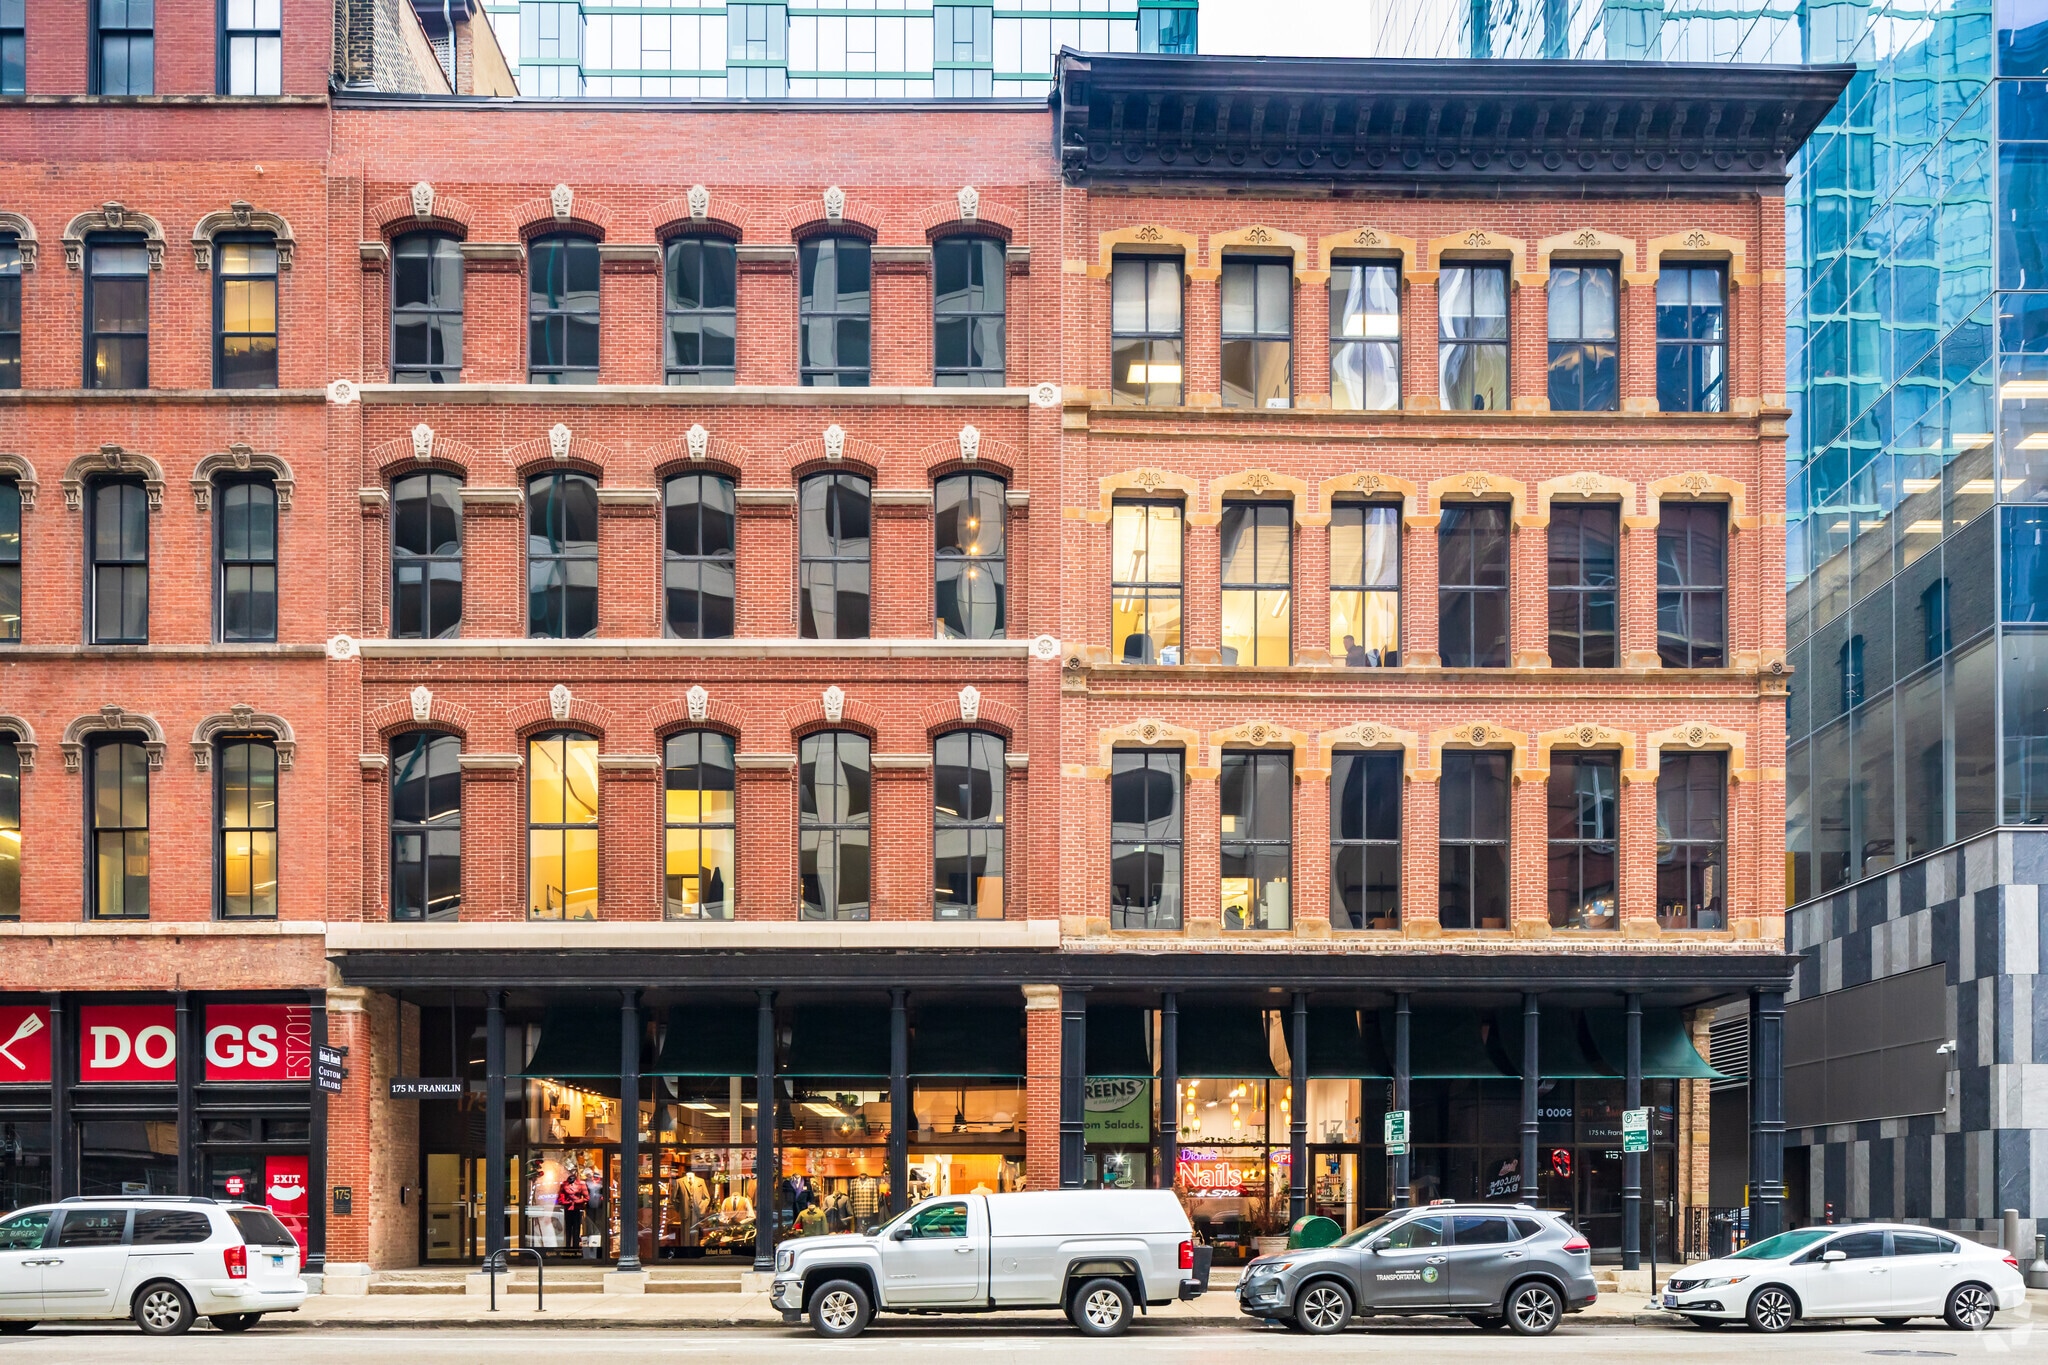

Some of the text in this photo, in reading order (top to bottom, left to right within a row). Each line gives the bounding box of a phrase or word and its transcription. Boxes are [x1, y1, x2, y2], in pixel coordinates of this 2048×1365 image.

[391, 1084, 461, 1093] 175 N. FRANKLIN
[1104, 1120, 1144, 1129] Salads.
[273, 1174, 301, 1184] EXIT
[1179, 1162, 1242, 1187] Nails
[335, 1189, 351, 1200] 175
[1206, 1189, 1241, 1199] Spa
[1376, 1273, 1421, 1281] TRANSPORTATION
